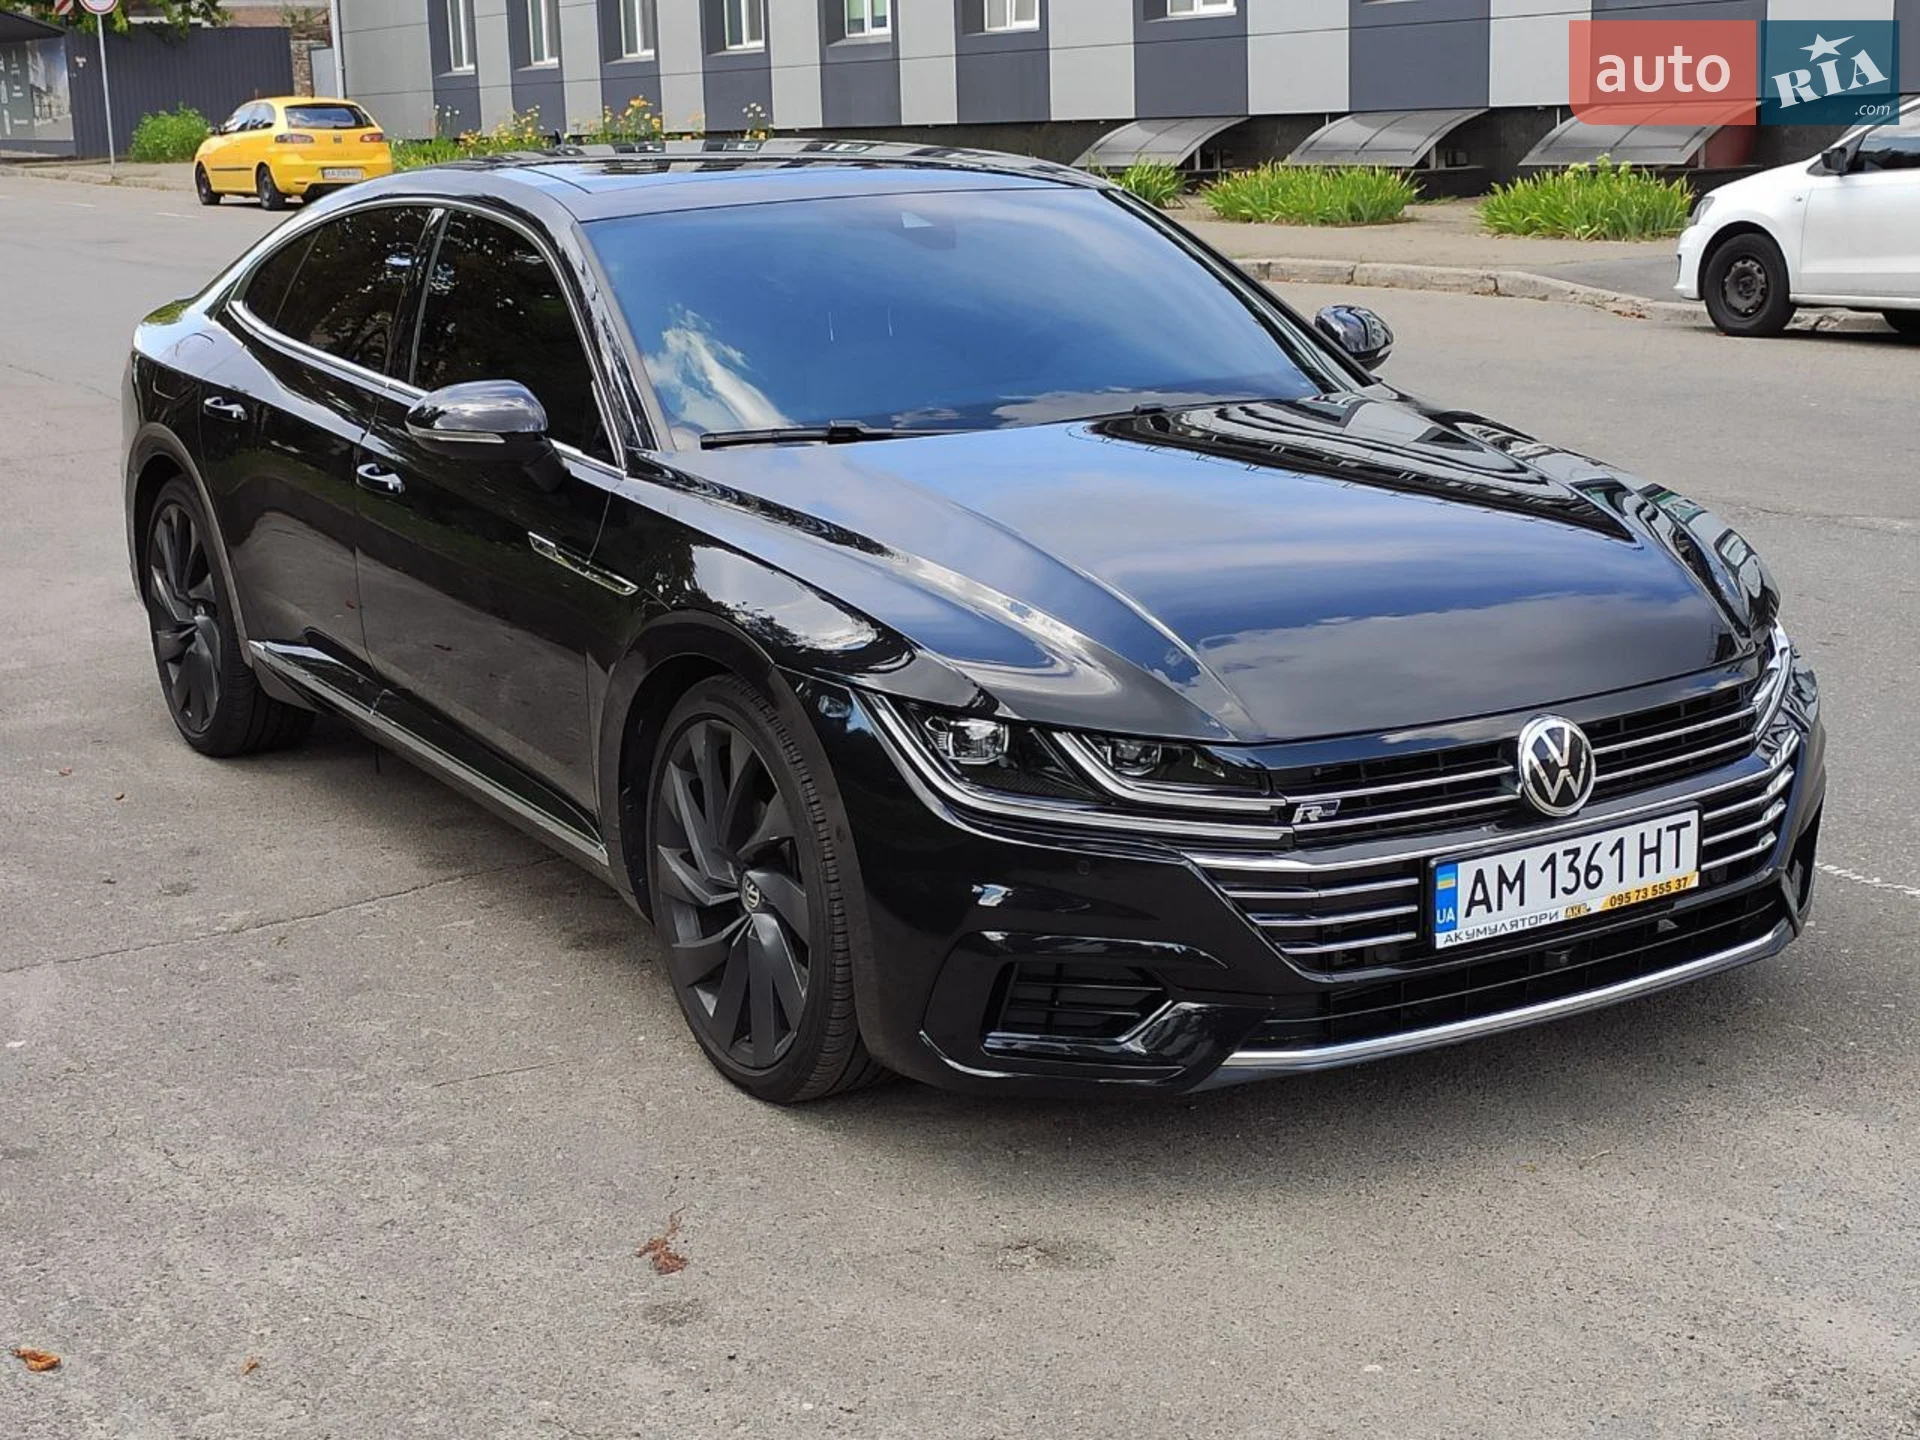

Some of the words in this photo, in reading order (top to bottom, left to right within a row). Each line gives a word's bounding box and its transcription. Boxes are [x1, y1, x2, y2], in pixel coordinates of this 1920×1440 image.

[1464, 859, 1525, 918] AM
[1540, 836, 1625, 900] 1361
[1638, 820, 1692, 879] HT
[1609, 891, 1632, 907] 095
[1634, 887, 1649, 901] 73
[1651, 881, 1672, 896] 555
[1674, 876, 1689, 891] 37
[1436, 907, 1456, 925] UA
[1443, 910, 1560, 945] АКУМУЛЯТОРИ
